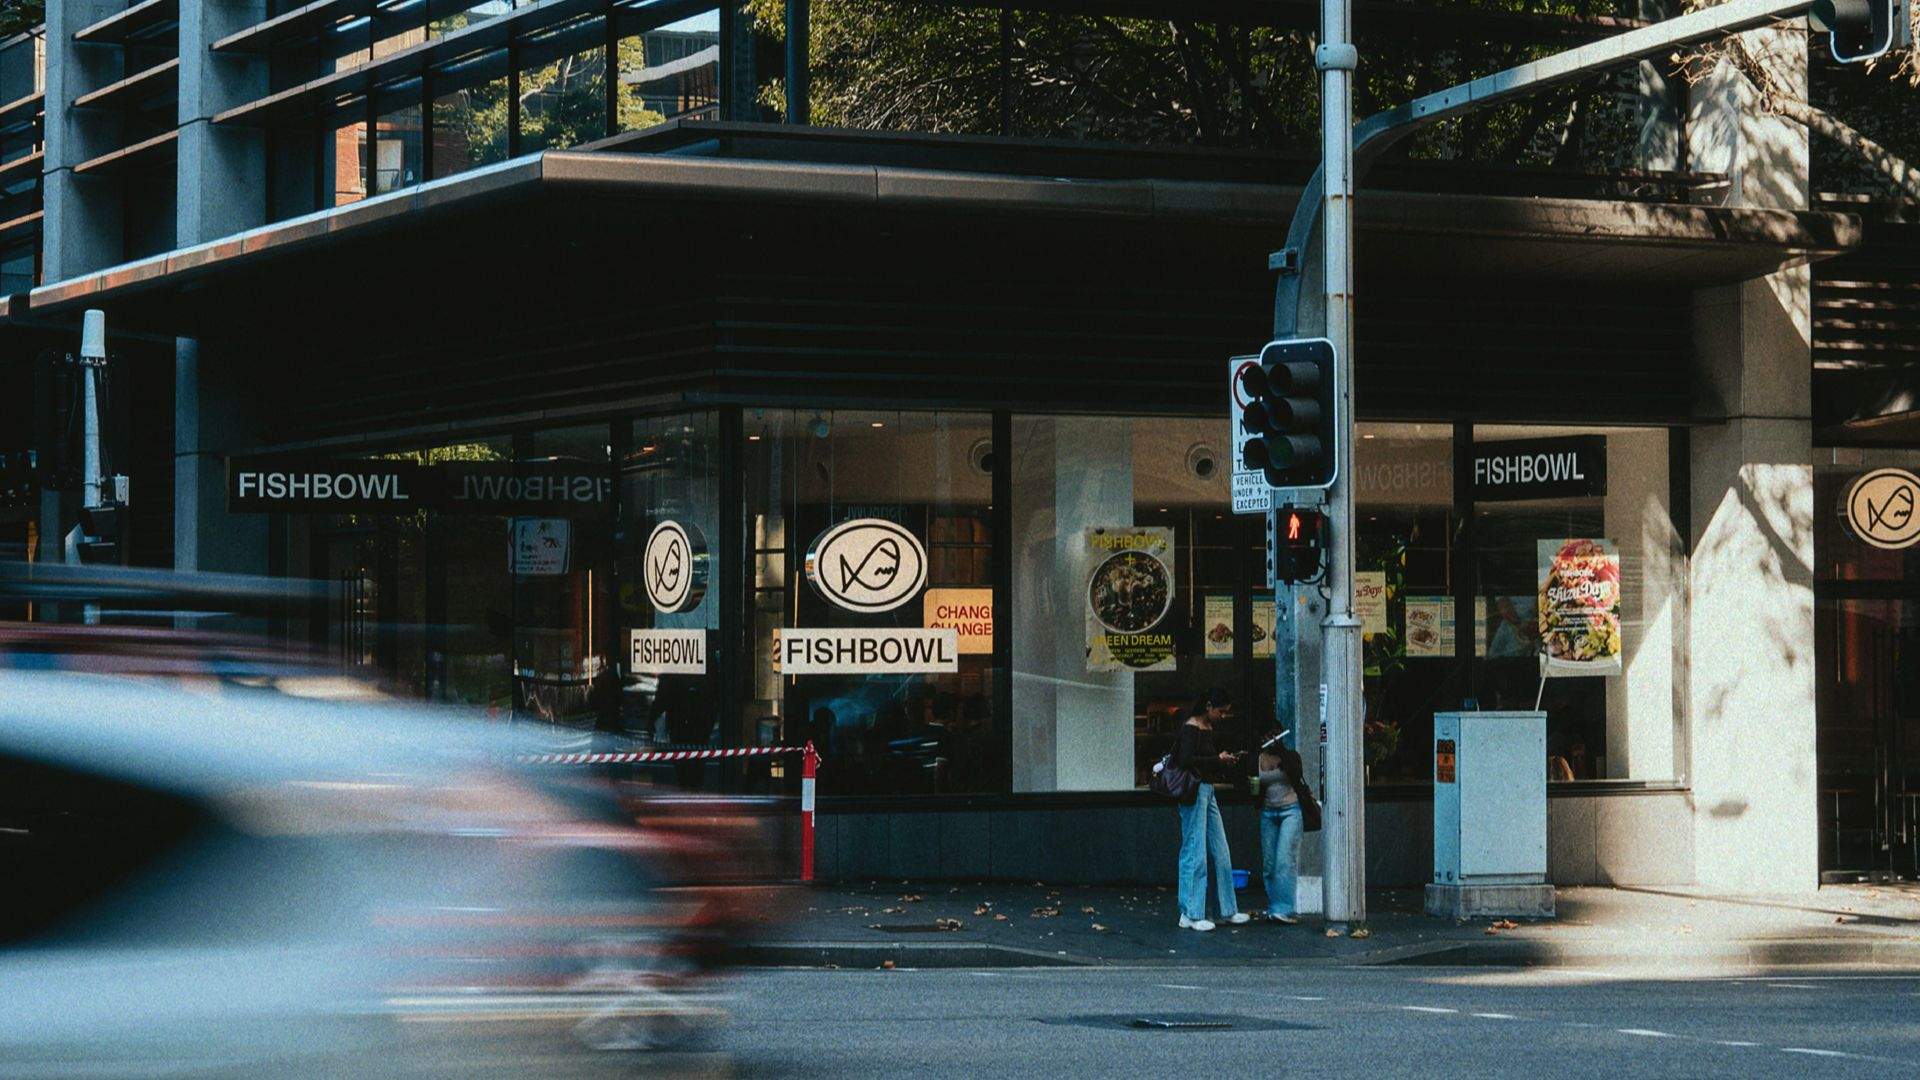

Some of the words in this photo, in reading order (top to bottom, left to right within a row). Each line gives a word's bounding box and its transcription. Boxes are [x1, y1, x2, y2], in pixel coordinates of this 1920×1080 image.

[1475, 452, 1585, 486] FISHBOWL
[239, 472, 409, 501] FISHBOWL
[1236, 475, 1264, 486] VEHICLE
[1233, 488, 1253, 498] UNDER
[1236, 498, 1269, 510] EXCEPTED
[937, 605, 993, 619] CHANG
[1131, 634, 1172, 645] DREAM
[633, 637, 705, 665] FISHBOWL
[787, 637, 954, 665] FISHBOWL
